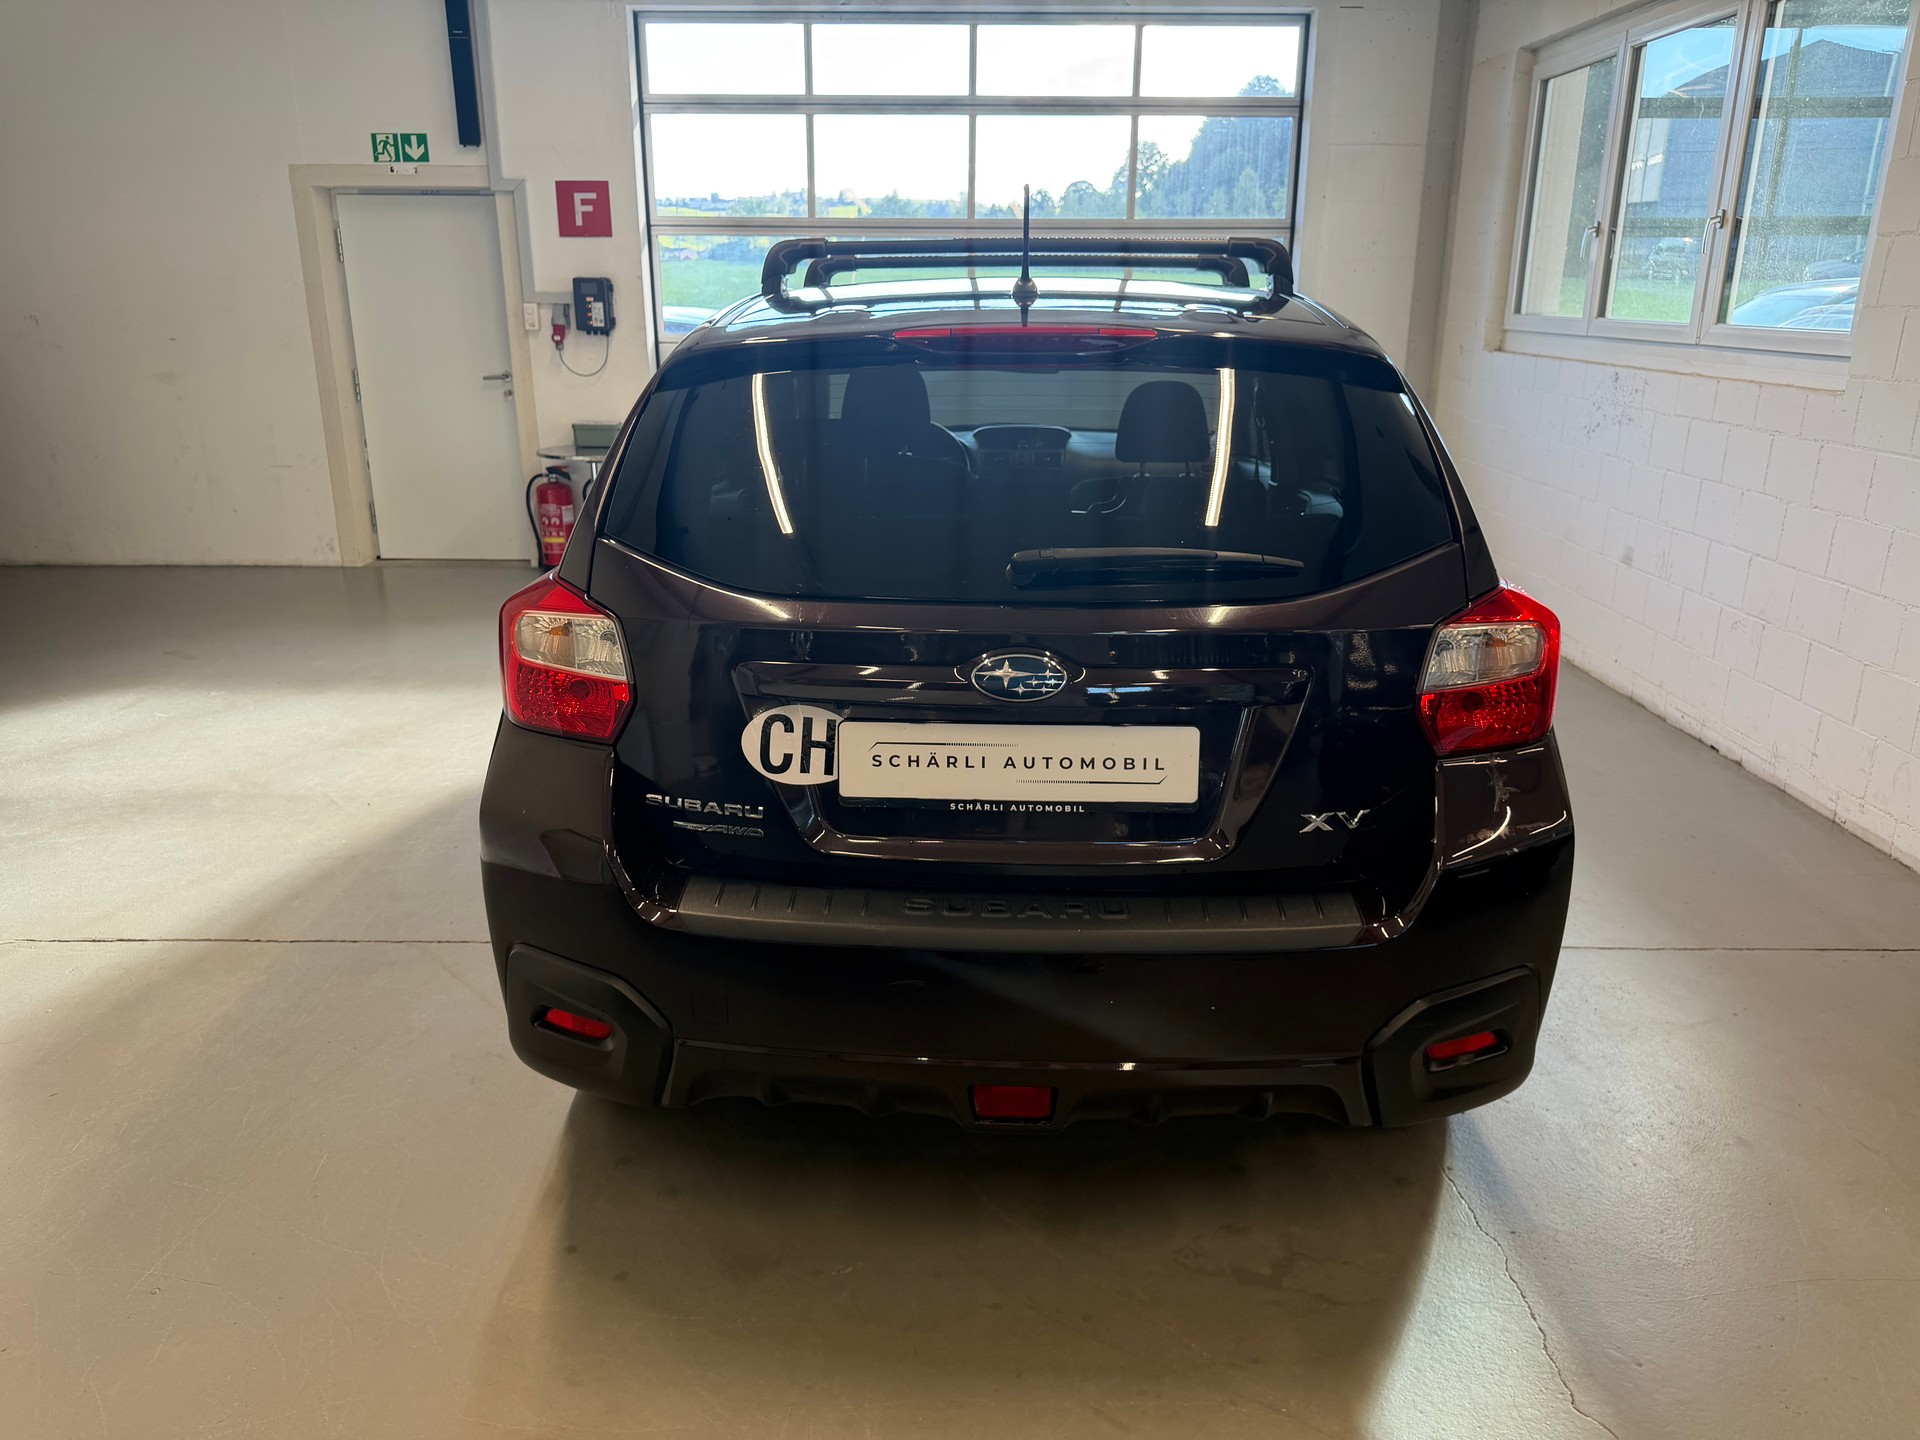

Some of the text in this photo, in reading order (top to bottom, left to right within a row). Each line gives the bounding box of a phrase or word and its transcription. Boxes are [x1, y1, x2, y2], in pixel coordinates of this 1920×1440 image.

[573, 192, 597, 227] F
[760, 713, 837, 777] CH
[871, 751, 1165, 771] SCHÄRLI AUTOMOBIL
[645, 793, 764, 819] SUBARU
[949, 801, 1086, 813] SCHÄRLI AUTOMOBIL
[1299, 809, 1370, 833] XV
[903, 898, 1130, 921] SUBARU
